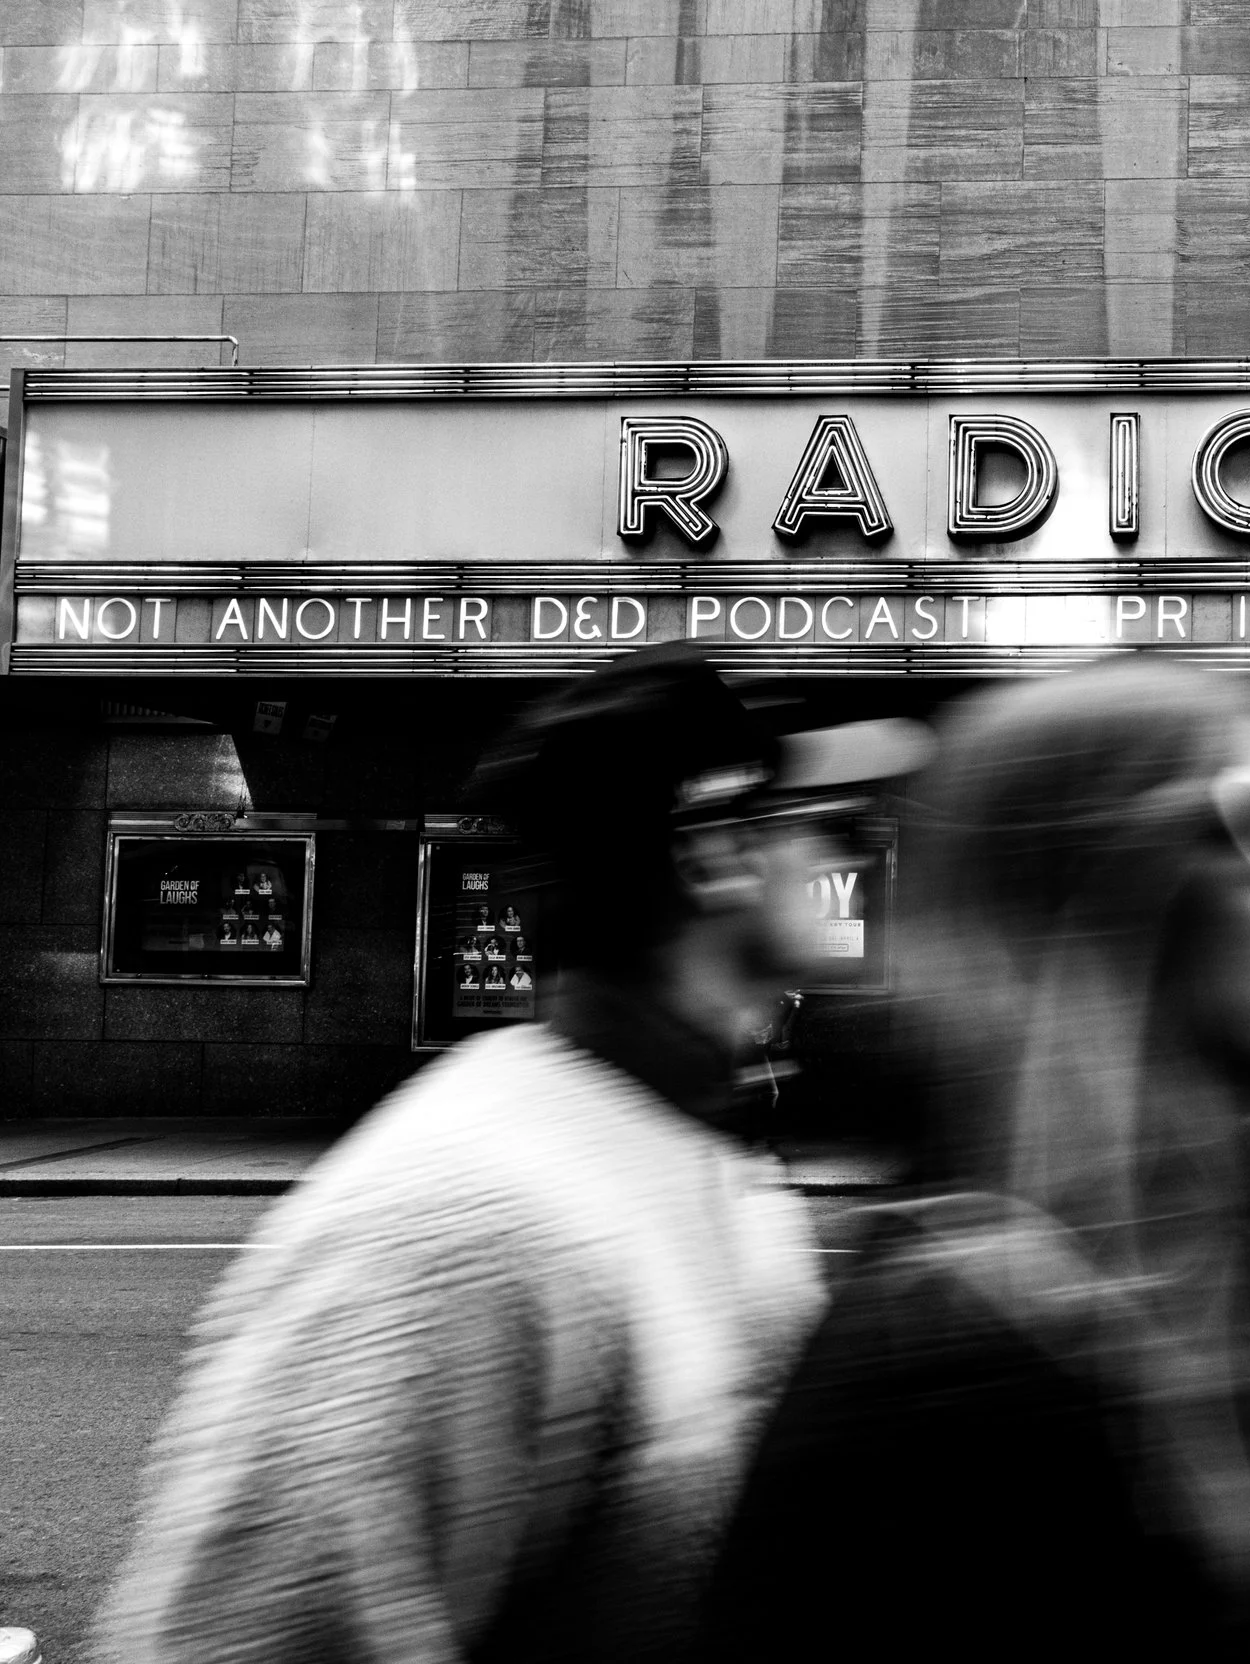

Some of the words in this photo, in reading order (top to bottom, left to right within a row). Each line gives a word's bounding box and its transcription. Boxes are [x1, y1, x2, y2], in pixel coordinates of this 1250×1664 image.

[57, 597, 171, 640] NOT
[215, 597, 489, 640] ANOTHER
[533, 596, 646, 640] D&D
[690, 595, 982, 639] PODCAST
[1090, 595, 1187, 639] PR
[160, 880, 190, 891] GARDEN
[190, 880, 200, 891] OF
[462, 880, 489, 890] LAUGHS
[160, 891, 198, 904] LAUGHS
